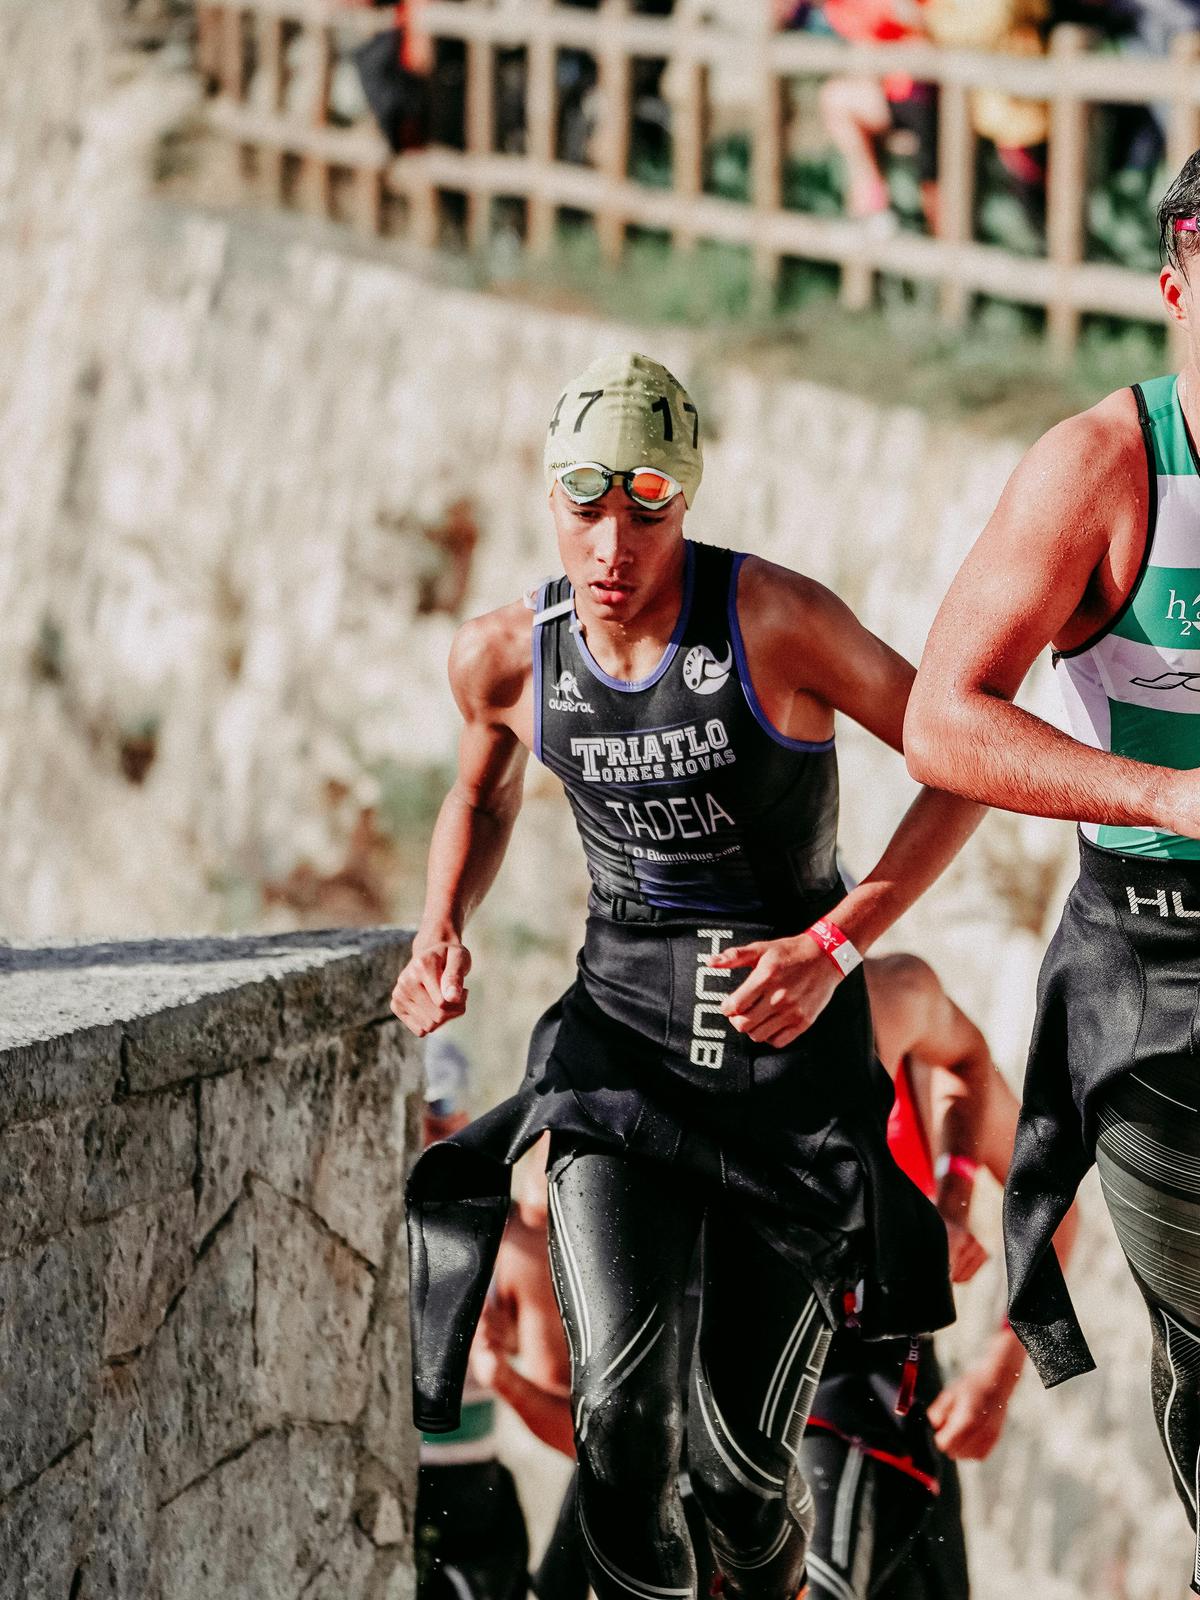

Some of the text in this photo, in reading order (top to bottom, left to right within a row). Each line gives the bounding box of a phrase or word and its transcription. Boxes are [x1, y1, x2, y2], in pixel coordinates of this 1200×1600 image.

[549, 698, 595, 714] austral
[570, 718, 729, 782] TRIATLO
[671, 749, 737, 777] NOVAS
[605, 793, 735, 841] TADEIA
[689, 928, 733, 1070] HUUB
